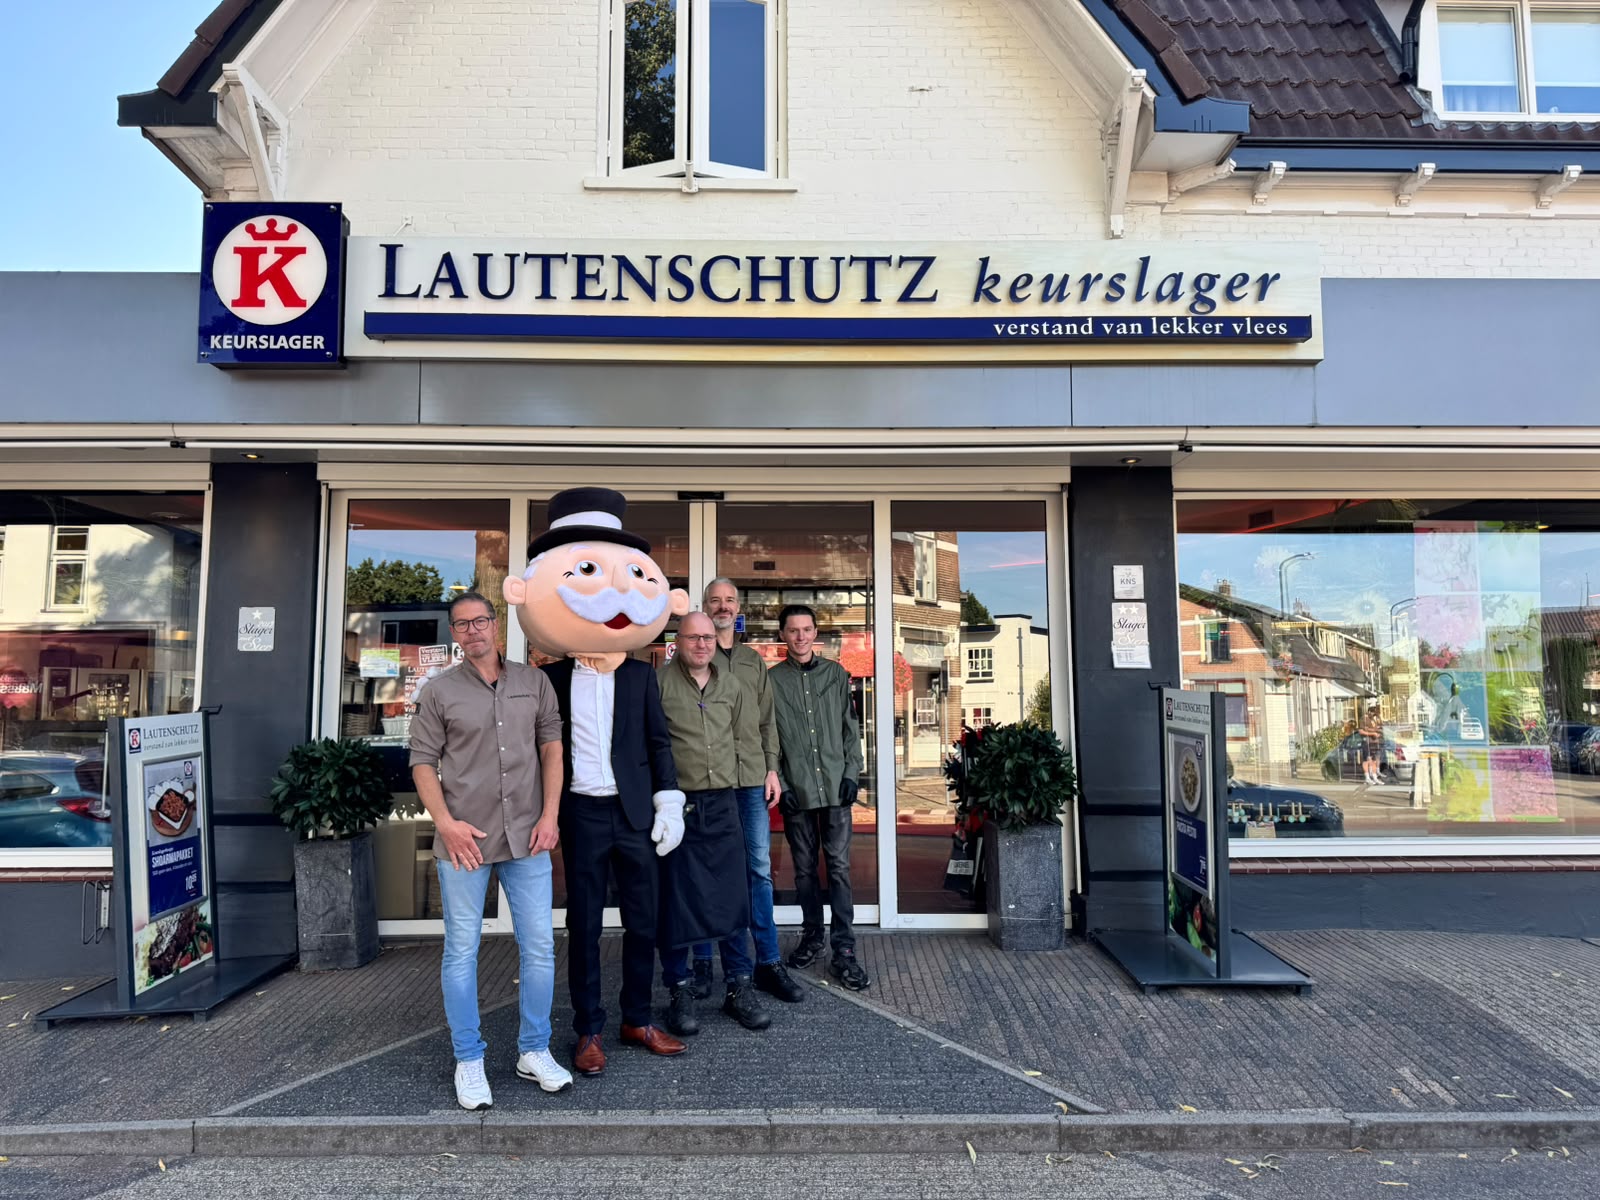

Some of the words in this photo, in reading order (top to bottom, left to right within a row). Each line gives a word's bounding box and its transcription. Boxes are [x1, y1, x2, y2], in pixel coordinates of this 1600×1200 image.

[231, 246, 307, 308] K
[378, 244, 939, 303] LAUTENSCHUTZ
[973, 254, 1281, 315] keurslager
[993, 317, 1094, 336] verstand
[1102, 321, 1143, 335] van
[1151, 316, 1225, 335] lekker
[1232, 317, 1289, 335] vlees
[210, 335, 325, 350] KEURSLAGER
[1120, 577, 1137, 585] KNS
[238, 622, 273, 637] Slager
[1113, 617, 1146, 632] Slager
[143, 724, 199, 740] LAUTENSCHUTZ
